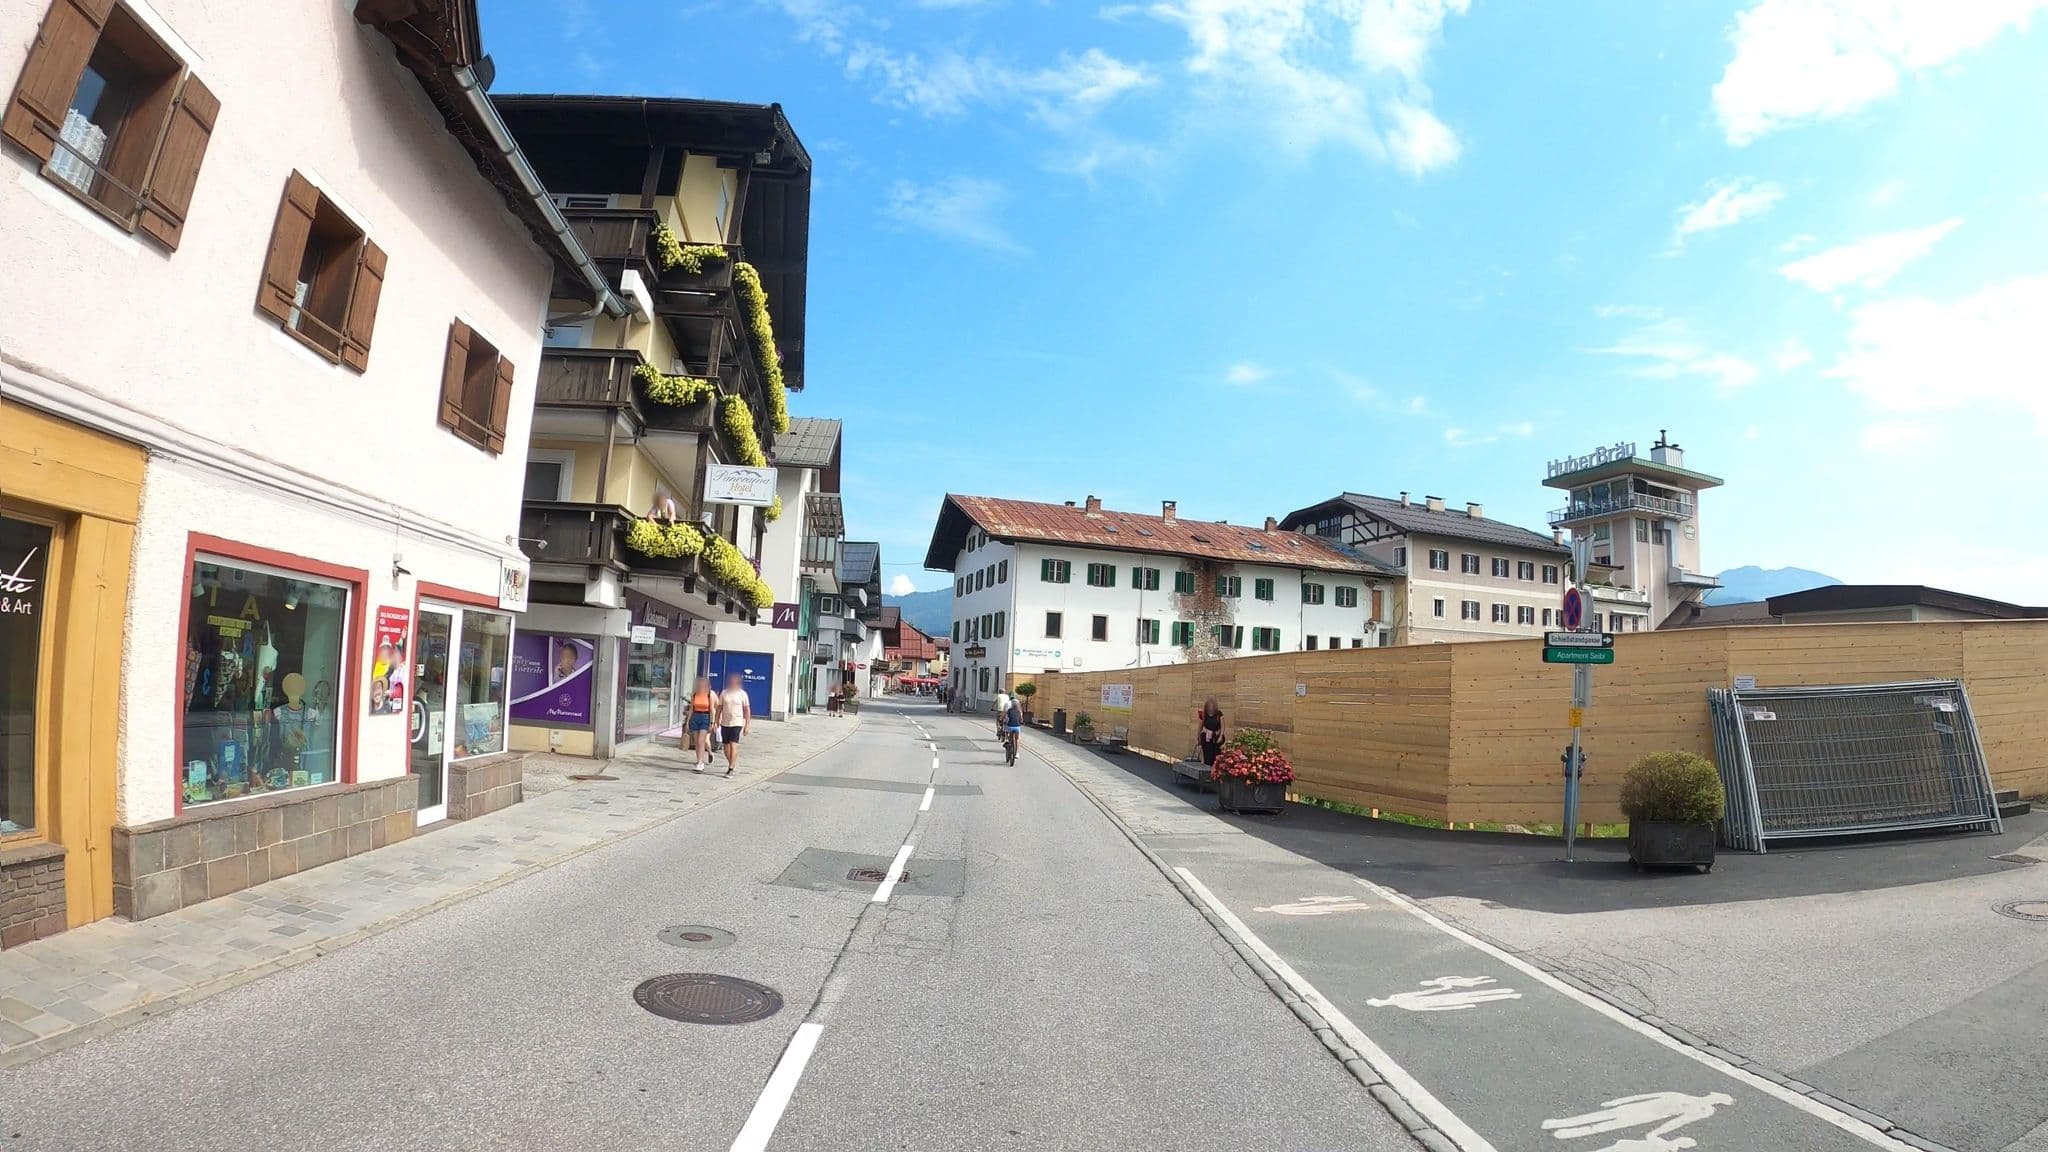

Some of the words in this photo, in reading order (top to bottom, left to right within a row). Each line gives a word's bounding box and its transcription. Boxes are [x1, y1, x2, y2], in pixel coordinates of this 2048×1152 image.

[1547, 441, 1636, 479] HuberBräu
[731, 482, 753, 492] Hotel
[13, 599, 32, 615] Art
[1557, 651, 1588, 660] Apartment
